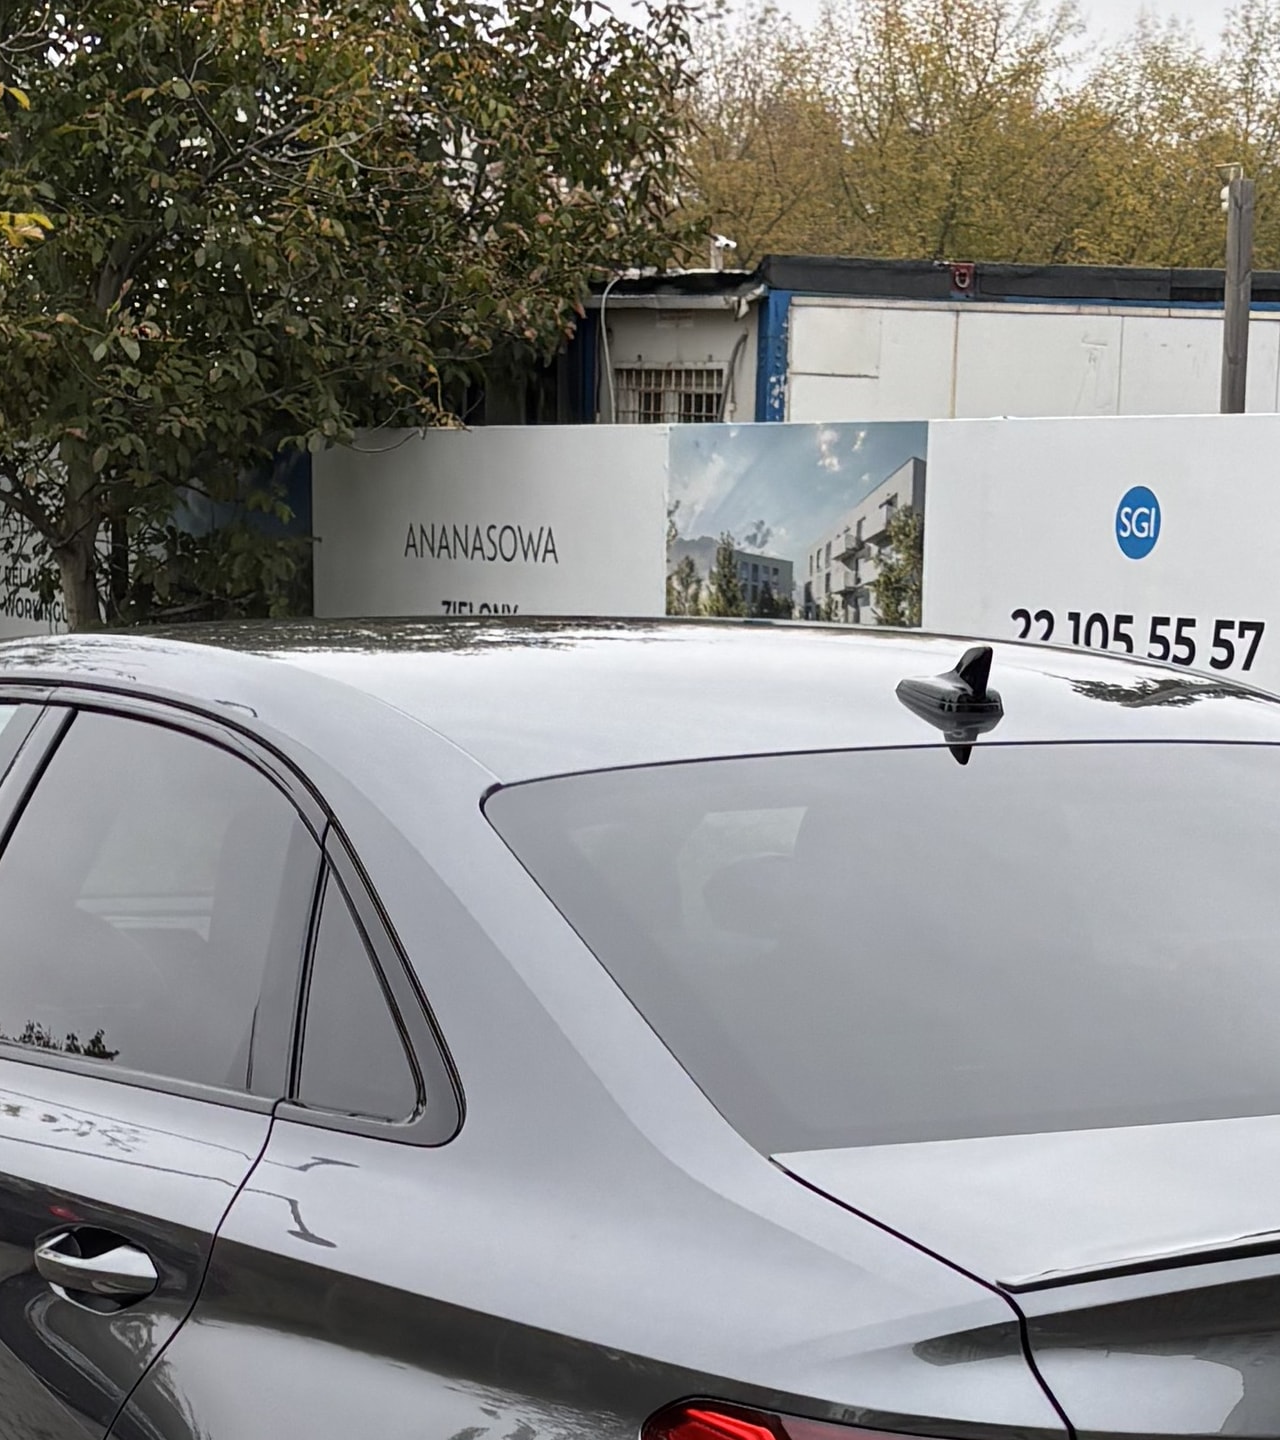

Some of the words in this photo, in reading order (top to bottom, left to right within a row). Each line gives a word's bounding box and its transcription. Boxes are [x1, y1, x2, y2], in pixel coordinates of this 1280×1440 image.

[404, 522, 559, 564] ANANASOWA
[1120, 507, 1156, 538] SGI
[1067, 611, 1134, 653] 105
[1147, 616, 1196, 666] 55
[1209, 619, 1265, 671] 57
